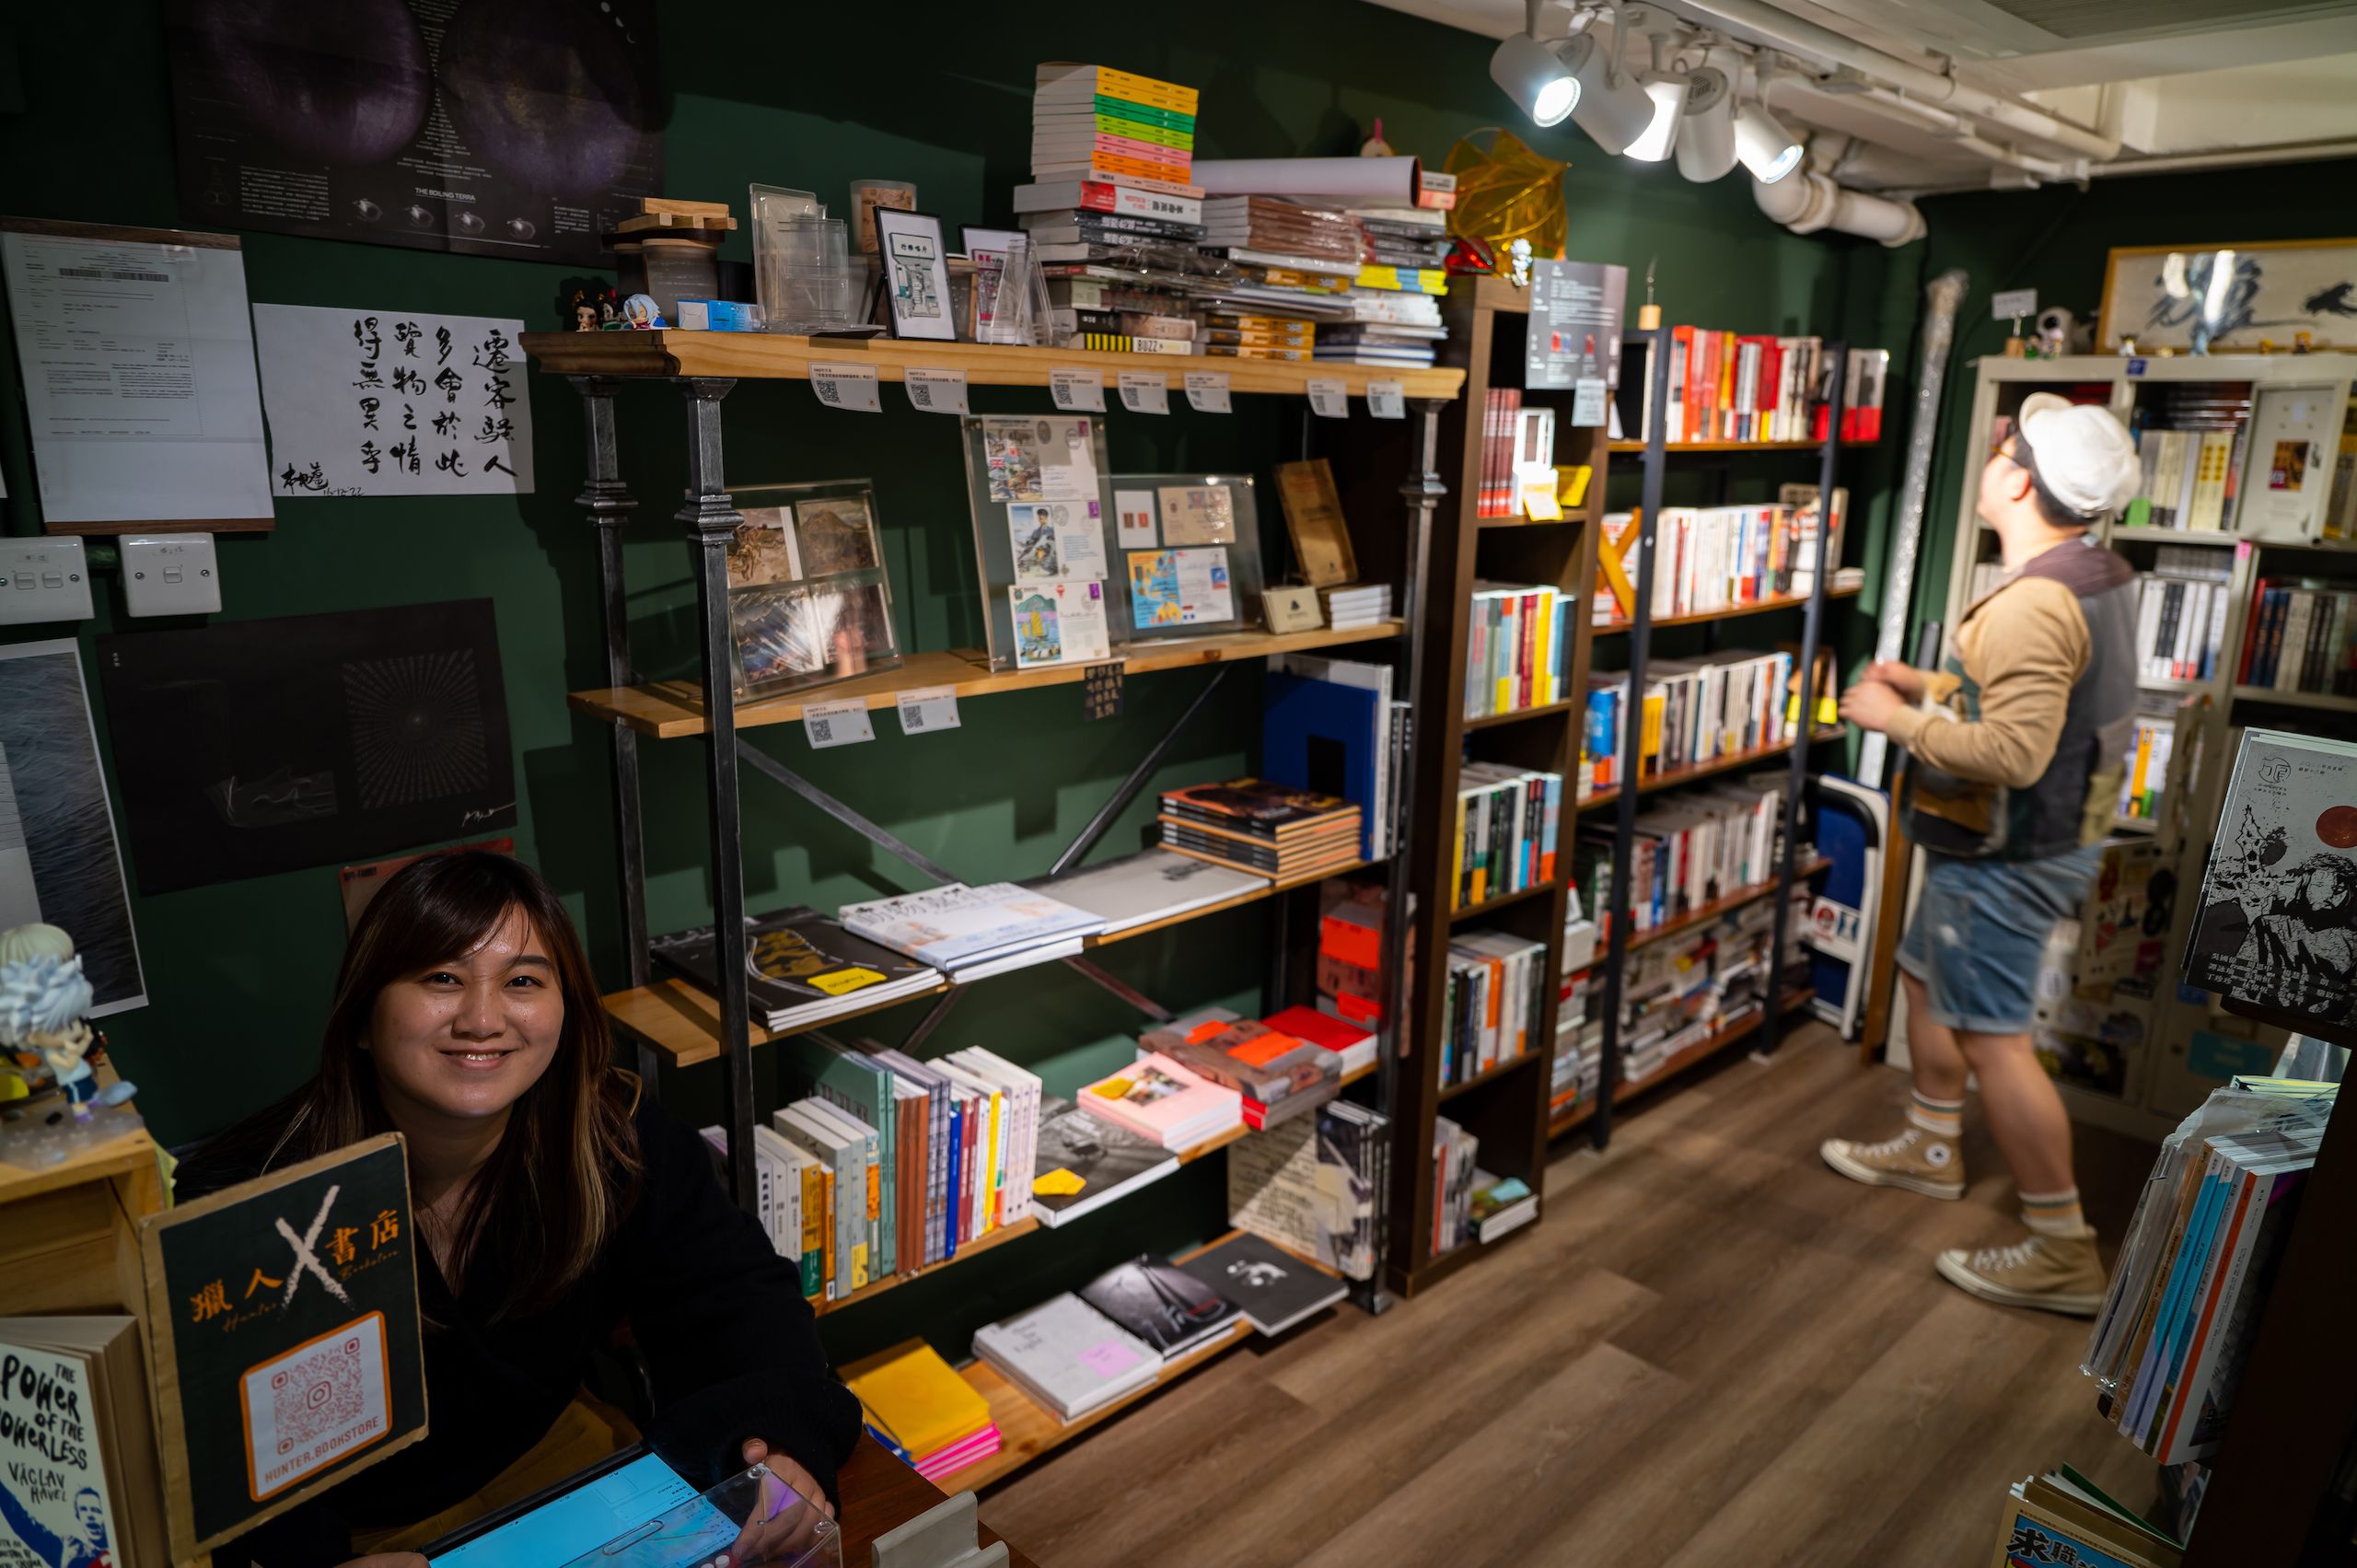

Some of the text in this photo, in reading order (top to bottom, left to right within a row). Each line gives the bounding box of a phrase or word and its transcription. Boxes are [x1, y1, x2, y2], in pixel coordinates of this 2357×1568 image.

[414, 187, 429, 196] THE
[1137, 340, 1158, 353] BUZZ
[190, 1267, 284, 1324] 獵人
[324, 1209, 401, 1266] 書店
[1, 1354, 81, 1423] POWER
[55, 1362, 76, 1384] THE
[0, 1407, 87, 1471] OWERLESS
[35, 1412, 85, 1443] OF THE
[264, 1415, 379, 1483] HUNTER.BOOKSTORE
[30, 1488, 68, 1505] HAVEL
